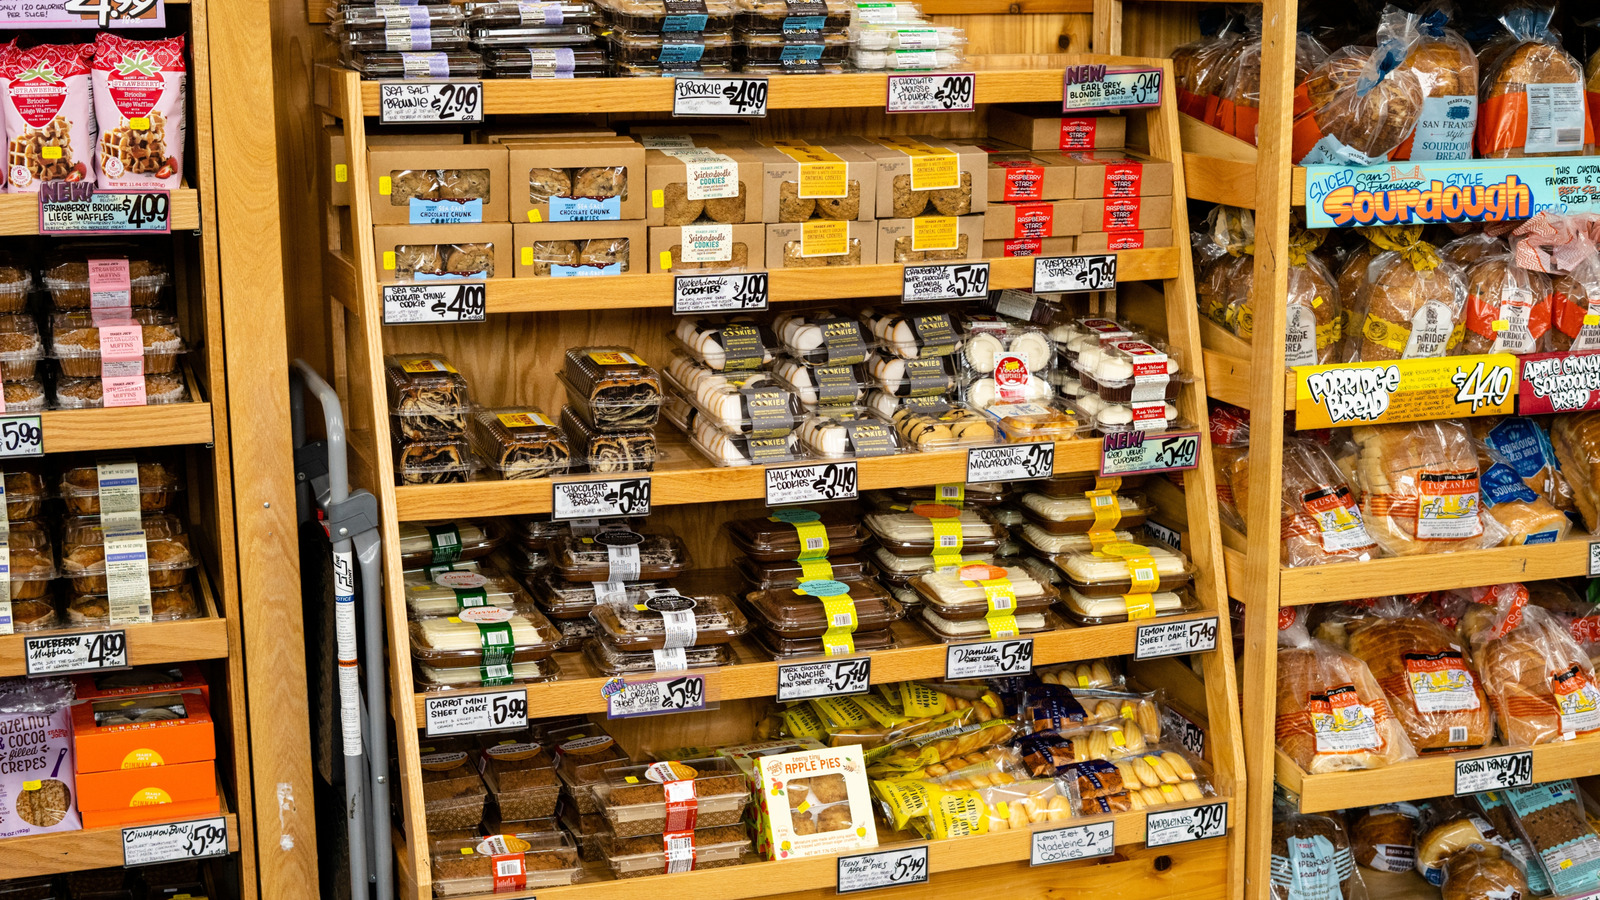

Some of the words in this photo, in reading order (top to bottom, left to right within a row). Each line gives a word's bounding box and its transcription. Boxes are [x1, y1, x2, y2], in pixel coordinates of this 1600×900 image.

[898, 77, 933, 85] CHOCOLATE
[1066, 65, 1107, 85] NEW!
[384, 85, 403, 96] SEA
[407, 85, 430, 95] SALT
[676, 82, 722, 97] BROOKIE
[901, 85, 930, 93] MOUSSE
[934, 76, 971, 109] $3.99
[1070, 90, 1101, 99] BLONDIE
[1104, 87, 1127, 97] BARS
[1081, 84, 1101, 92] EARL
[1102, 81, 1122, 90] GREY
[1131, 73, 1161, 103] $3.49
[384, 97, 429, 109] BROWNIE
[431, 83, 478, 119] $2.99
[722, 80, 767, 113] $4.99
[898, 92, 934, 101] FLOWERS
[133, 100, 155, 108] Waffles
[1422, 120, 1440, 129] SAN
[1445, 130, 1465, 142] style
[1435, 151, 1467, 160] BREAD
[693, 170, 731, 181] Snickerdoodle
[1555, 165, 1571, 175] THIS
[1309, 168, 1354, 204] SLICED
[1355, 172, 1391, 185] San
[1446, 172, 1484, 187] STYLE
[1355, 179, 1426, 193] Francisco
[1545, 176, 1579, 186] FAVORITE
[1585, 175, 1592, 184] IS
[40, 181, 94, 203] NEW!
[1558, 185, 1581, 196] BEST
[1560, 194, 1588, 204] SLICED
[43, 203, 91, 213] STRAWBERRY
[92, 203, 123, 212] BRIOCHE
[48, 212, 72, 222] LIEGE
[76, 212, 114, 222] WAFFLES
[1042, 257, 1085, 270] RASPBERRY
[906, 268, 941, 276] CRANBERRY
[922, 273, 950, 282] CHOCOLATE
[1075, 256, 1116, 290] $5.99
[946, 266, 988, 296] $5.49
[385, 293, 421, 303] CHOCOLATE
[423, 291, 446, 300] CHUNK
[409, 286, 428, 294] SALT
[681, 285, 721, 296] COOKIES
[914, 286, 943, 295] COOKIES
[399, 300, 426, 308] COOKIE
[431, 285, 485, 320] $4.99
[1522, 358, 1562, 382] APPLE
[1307, 365, 1401, 404] PORRIDGE
[1451, 362, 1514, 413] $4.49
[1325, 389, 1389, 424] BREAD
[1549, 389, 1591, 412] BREAD
[1104, 431, 1145, 452] NEW!
[1126, 447, 1148, 457] VELVET
[1155, 436, 1196, 467] $5.49
[970, 456, 1022, 470] MACAROONS
[1021, 444, 1053, 478] $3.79
[1113, 455, 1143, 465] CUPCAKES
[769, 471, 789, 483] HALF
[790, 468, 815, 479] MOON
[812, 464, 856, 499] $3.49
[562, 482, 608, 494] CHOCOLATE
[1428, 481, 1461, 490] TUSCAN
[567, 490, 605, 501] BROOKLYN
[571, 497, 600, 507] BABKA
[604, 481, 650, 514] $5.99
[1140, 626, 1165, 638] LEMON
[1167, 624, 1186, 633] MINI
[1140, 635, 1164, 646] SHEET
[1167, 630, 1188, 641] CAKE
[29, 637, 82, 651] BLUEBERRY
[30, 648, 75, 660] Muffins
[954, 645, 999, 663] Vanilla
[800, 663, 832, 671] CHOCOLATE
[780, 679, 794, 689] MINI
[795, 676, 812, 686] SHEET
[813, 675, 831, 684] CAKE
[787, 670, 825, 680] GANACHE
[827, 661, 868, 692] $5.49
[604, 678, 626, 695] NEW!
[661, 677, 703, 709] $5.99
[630, 688, 660, 700] CREAM
[429, 698, 464, 710] CARROT
[465, 696, 488, 706] MINI
[613, 698, 636, 708] SHEET
[639, 696, 660, 705] CAKE
[431, 708, 459, 719] SHEET
[462, 703, 488, 714] CAKE
[9, 745, 38, 761] filled
[792, 755, 808, 763] teeny
[808, 754, 820, 762] tiny
[1, 756, 47, 775] CREPES
[785, 760, 817, 774] APPLE
[1457, 760, 1484, 777] TUSCAN
[1487, 758, 1508, 772] PANE
[1497, 755, 1531, 787] $3.49
[1149, 815, 1193, 829] MADELEINES
[1187, 804, 1224, 840] $3.29
[125, 828, 169, 843] CINNAMON
[1036, 833, 1058, 842] Lemon
[1059, 829, 1079, 839] Zest
[1037, 837, 1086, 852] Madeleine
[1040, 848, 1084, 861] Cookies
[840, 859, 861, 868] TEENY
[861, 857, 875, 867] TINY
[847, 865, 868, 874] APPLE
